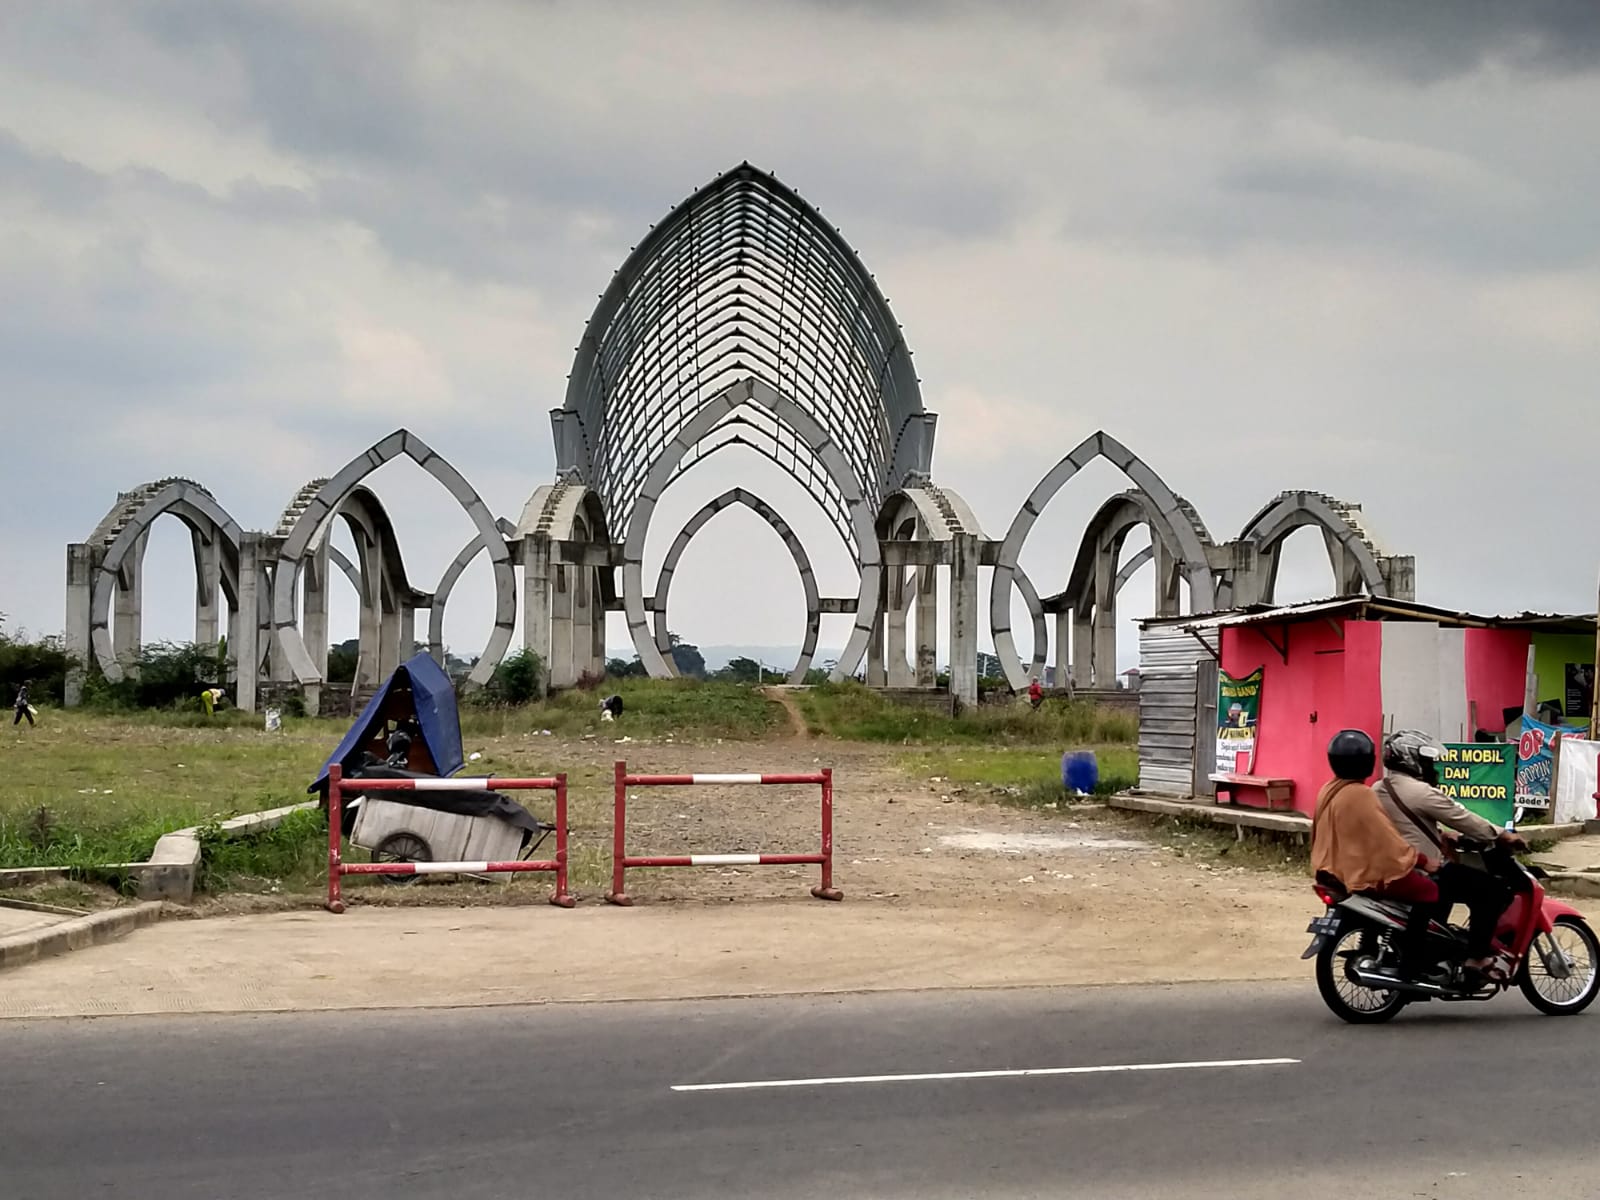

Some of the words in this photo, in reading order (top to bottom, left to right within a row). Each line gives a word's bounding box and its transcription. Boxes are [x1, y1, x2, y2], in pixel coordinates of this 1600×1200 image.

[1461, 749, 1504, 763] MOBIL
[1445, 767, 1469, 779] DAN
[1460, 784, 1506, 799] MOTOR
